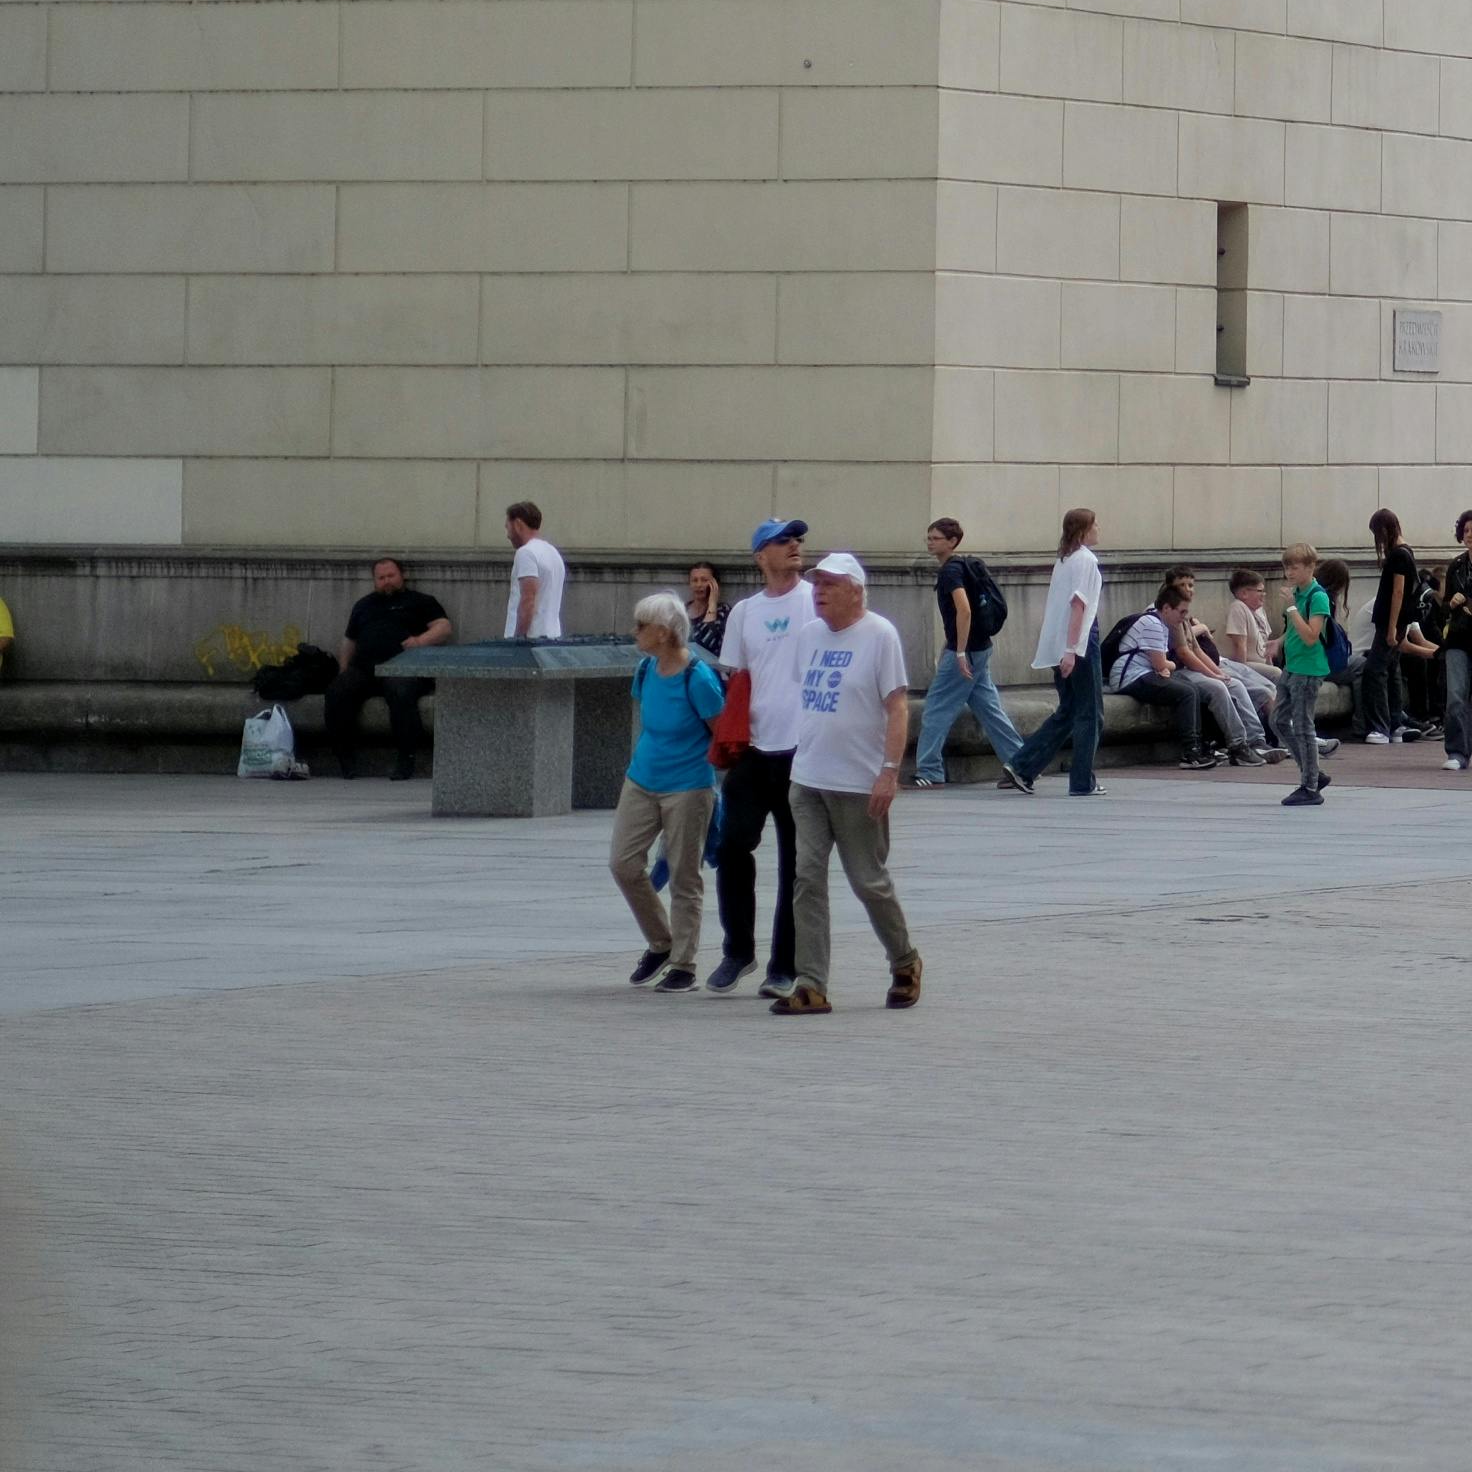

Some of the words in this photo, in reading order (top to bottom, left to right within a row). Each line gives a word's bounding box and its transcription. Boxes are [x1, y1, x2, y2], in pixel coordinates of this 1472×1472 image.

[810, 649, 819, 667] I
[820, 650, 853, 668] NEED
[803, 669, 826, 688] MY
[802, 689, 840, 713] SPACE
